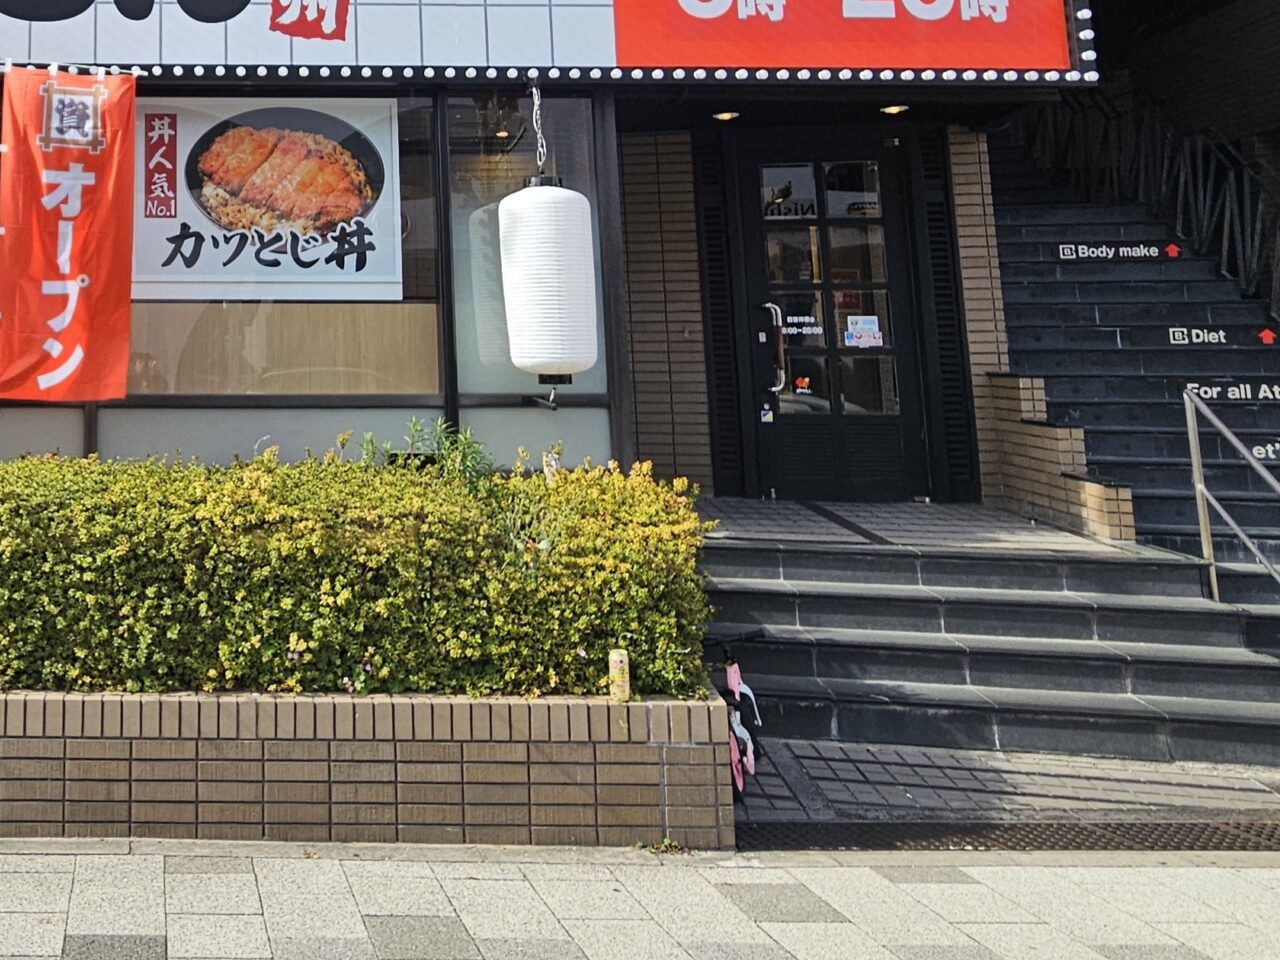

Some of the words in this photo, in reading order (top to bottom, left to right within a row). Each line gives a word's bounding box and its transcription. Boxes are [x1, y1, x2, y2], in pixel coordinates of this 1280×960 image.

[161, 221, 377, 273] カツとじ丼
[1078, 244, 1115, 259] Body
[1119, 243, 1159, 258] make
[36, 162, 95, 391] オープン
[1191, 328, 1227, 344] Diet
[1186, 383, 1222, 399] For
[1227, 384, 1252, 399] all
